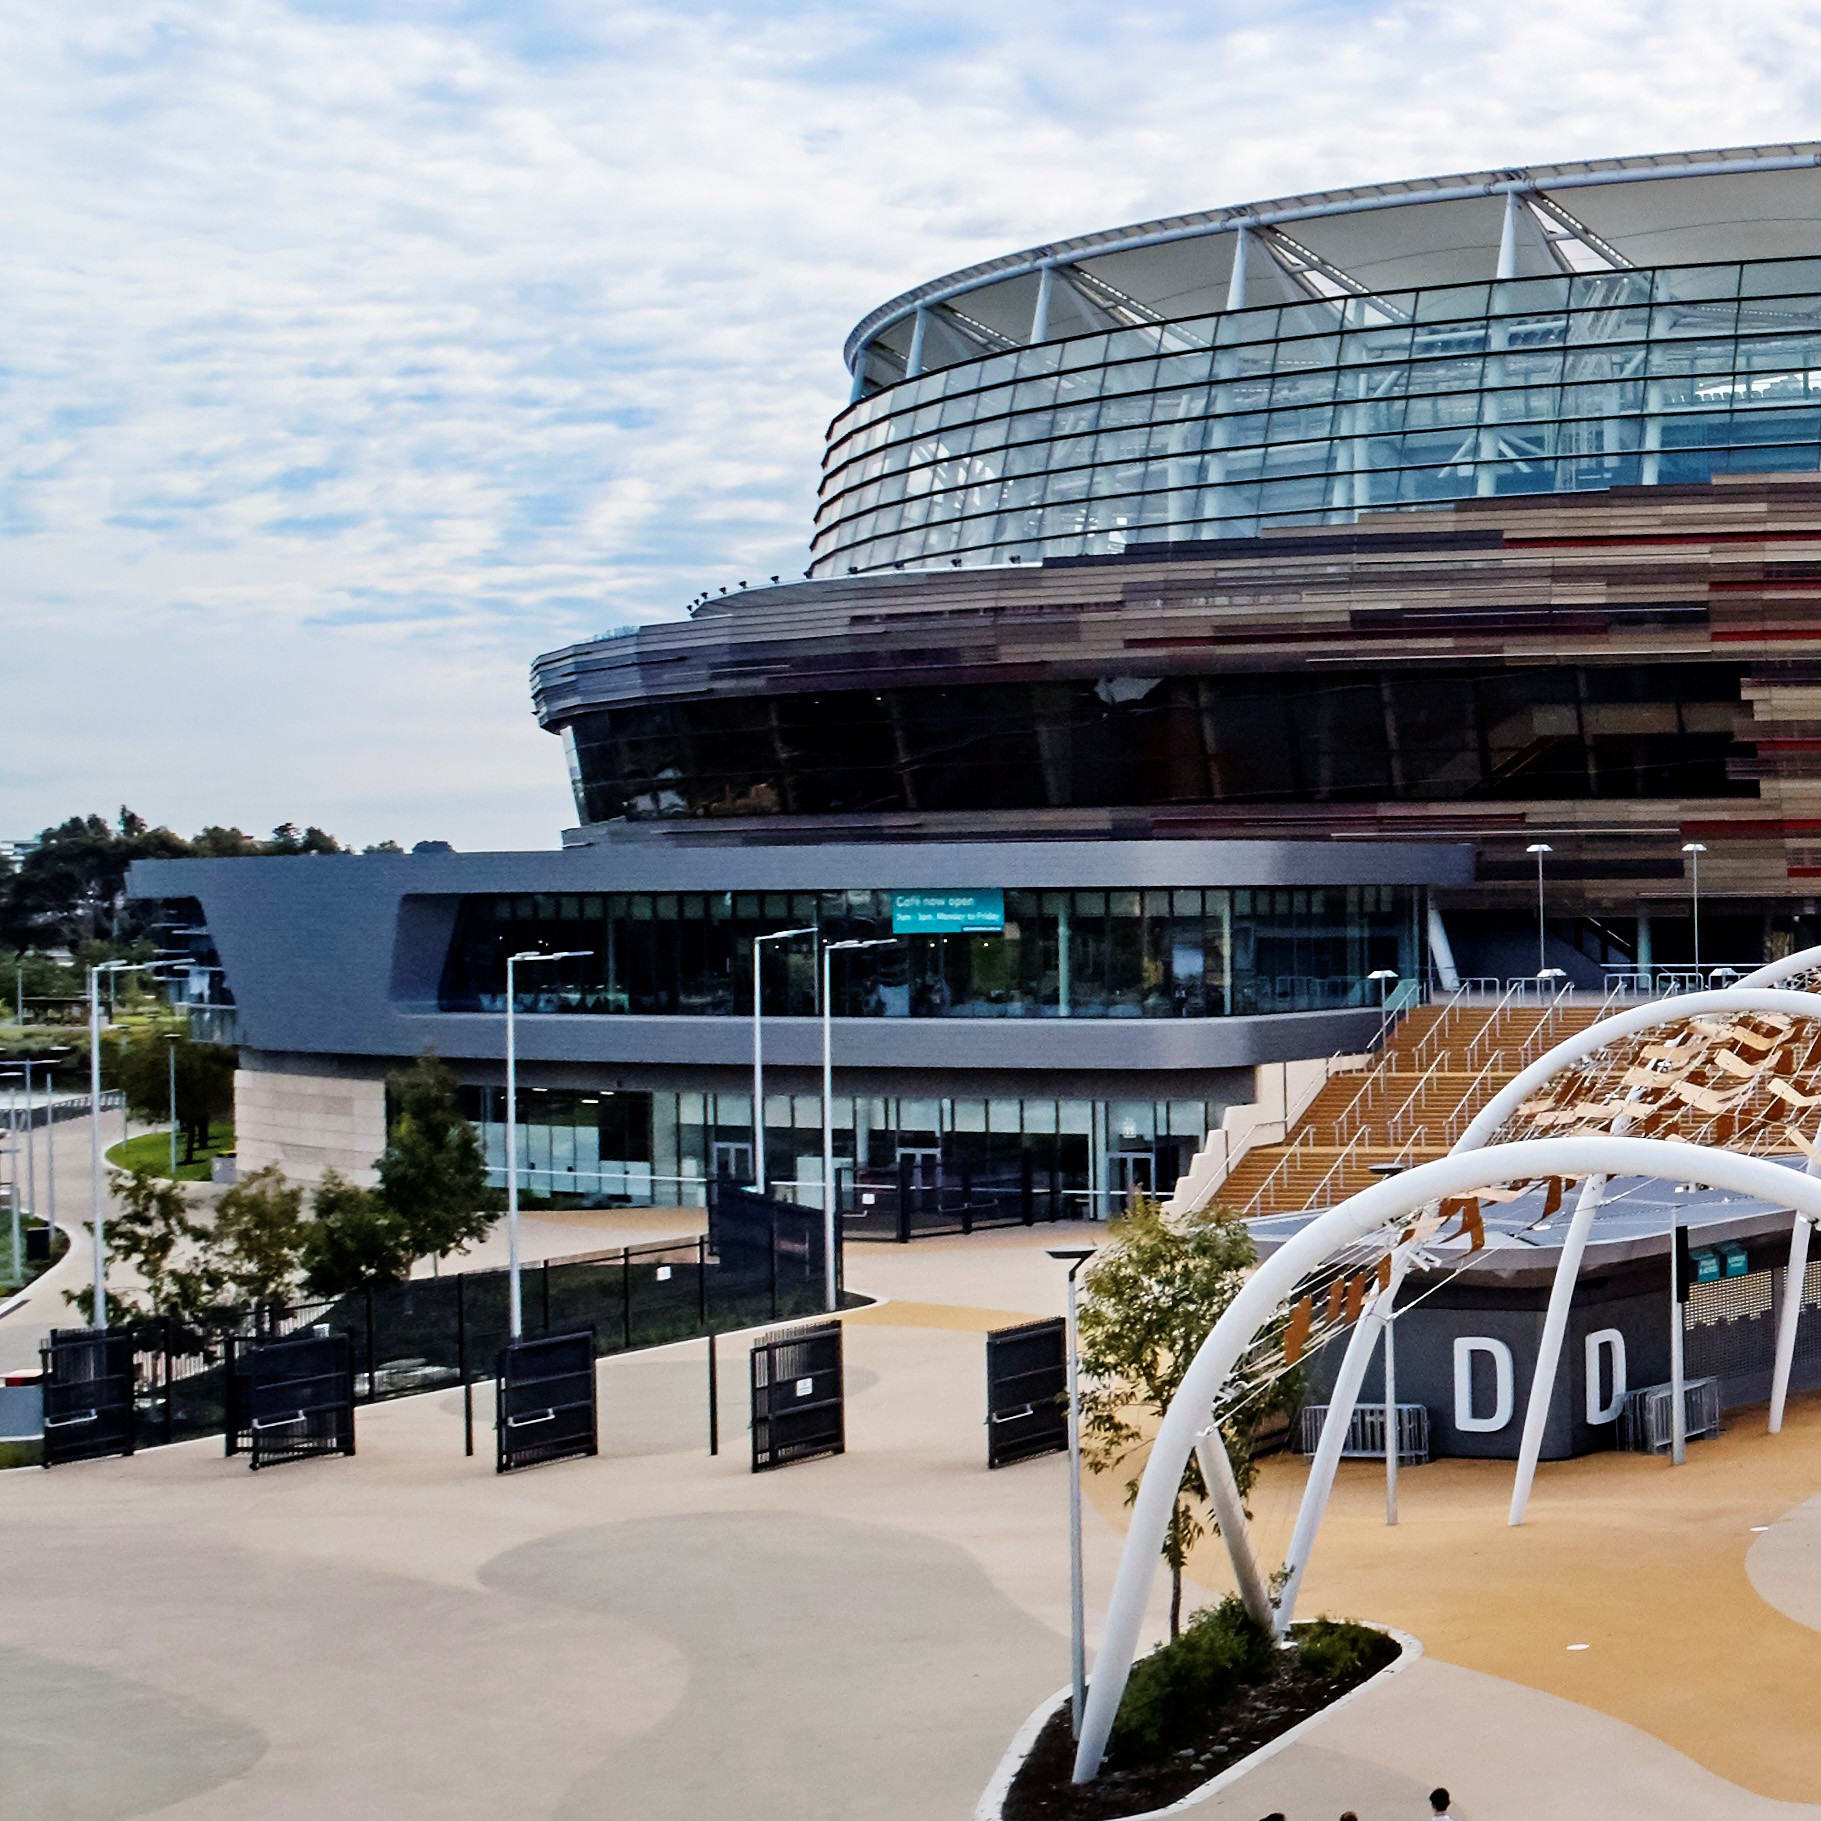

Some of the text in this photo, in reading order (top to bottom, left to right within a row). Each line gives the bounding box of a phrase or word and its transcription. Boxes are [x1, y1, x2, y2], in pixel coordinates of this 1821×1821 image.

[948, 897, 975, 908] open
[1454, 1337, 1514, 1432] D
[1585, 1328, 1627, 1425] D
